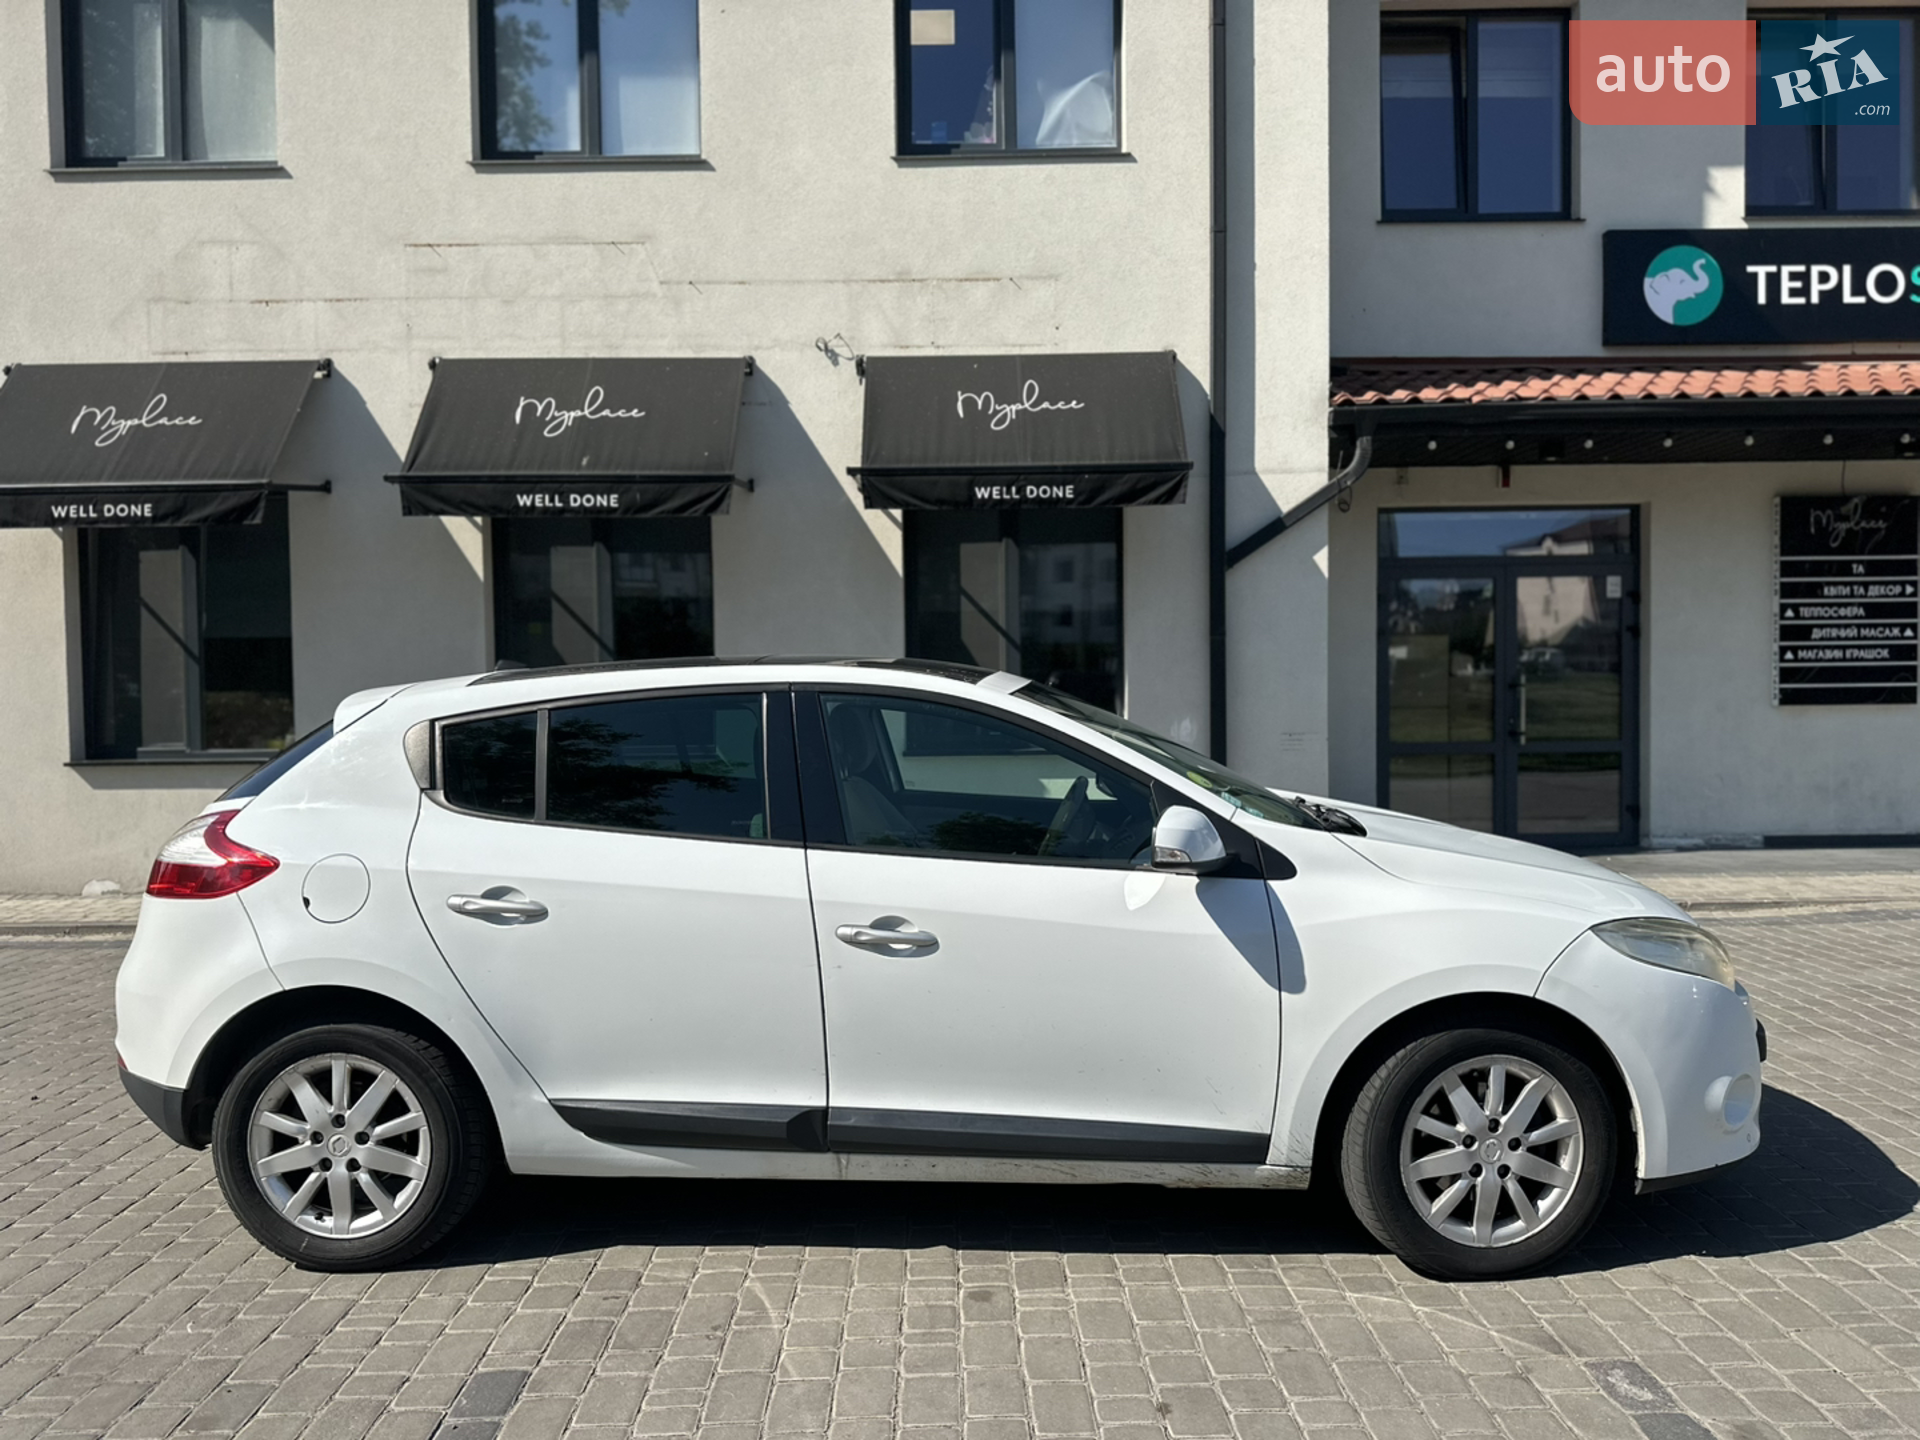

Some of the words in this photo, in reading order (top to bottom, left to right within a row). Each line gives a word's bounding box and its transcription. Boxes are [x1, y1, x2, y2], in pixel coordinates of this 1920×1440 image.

[515, 385, 645, 437] Myplace
[957, 379, 1085, 430] Myplace
[71, 393, 202, 447] Myplace
[975, 485, 1020, 500] WELL
[1026, 484, 1074, 499] DONE
[516, 493, 563, 507] WELL
[569, 493, 619, 507] DONE
[51, 504, 97, 518] WELL
[103, 503, 152, 518] DONE
[1852, 563, 1865, 574] ТА
[1853, 585, 1865, 595] ТА
[1867, 584, 1902, 597] ДЕКОР
[1860, 627, 1901, 638] МАСАЖ
[1798, 649, 1843, 660] МАГАЗИН
